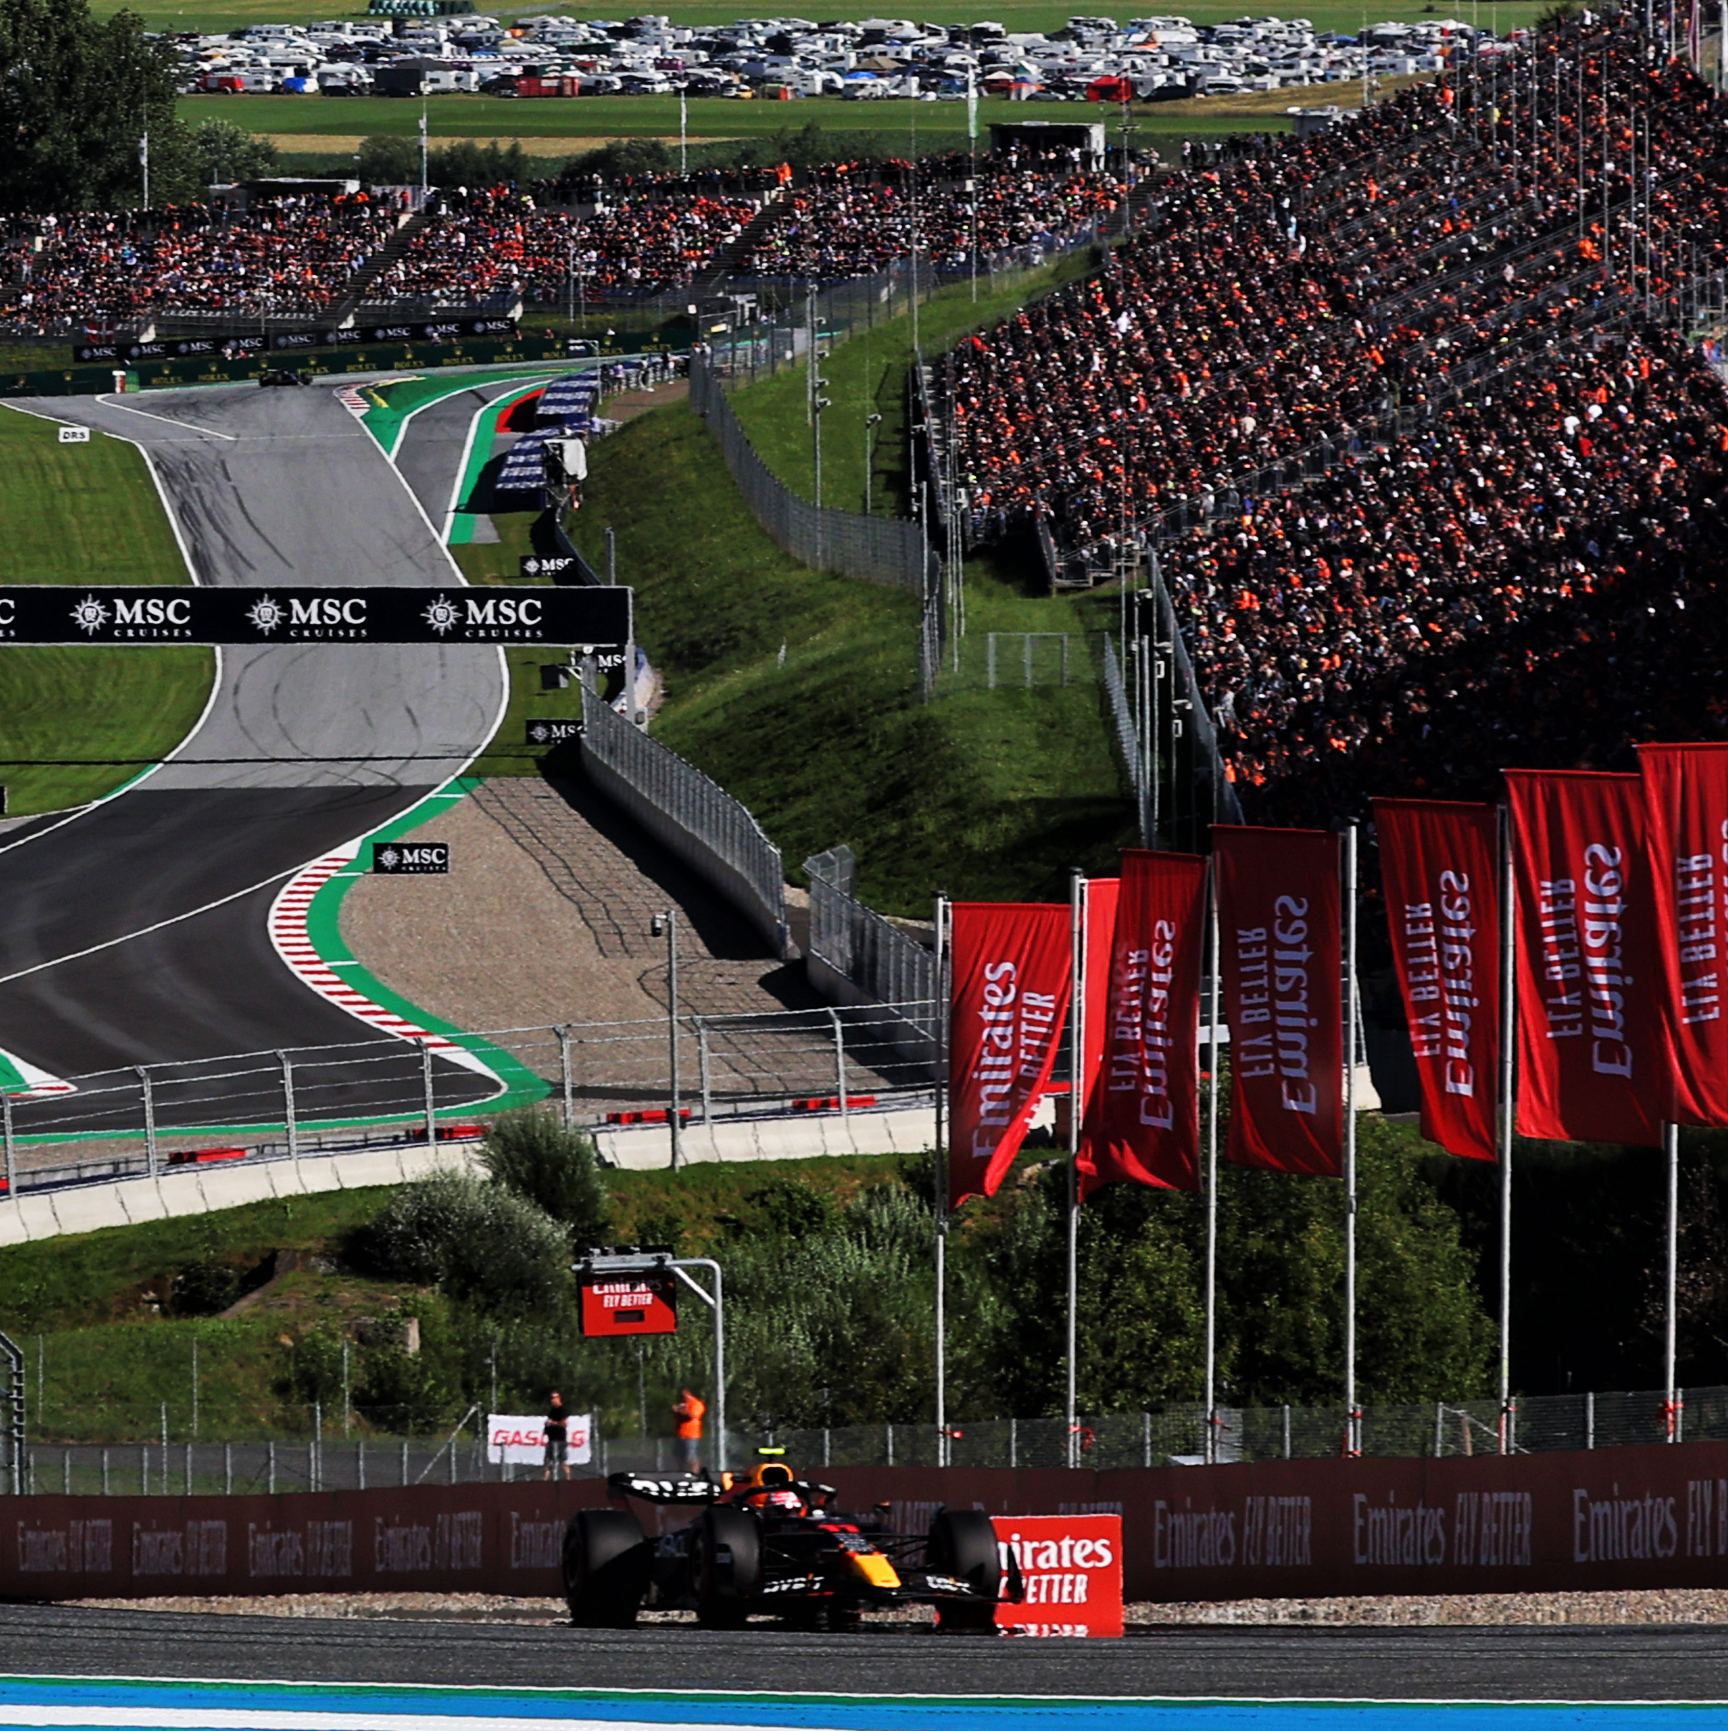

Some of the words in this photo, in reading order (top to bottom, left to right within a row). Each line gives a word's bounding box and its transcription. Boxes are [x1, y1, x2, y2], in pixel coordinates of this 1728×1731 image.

[63, 431, 86, 440] DRS
[113, 598, 191, 625] MSC
[289, 598, 367, 625] MSC
[465, 598, 542, 625] MSC
[113, 628, 192, 638] CRUISES
[289, 628, 368, 638] CRUISES
[465, 628, 543, 638] CRUISES
[402, 848, 446, 864] MSC
[1154, 1496, 1237, 1568] Emirates
[1353, 1490, 1445, 1565] Emirates
[1480, 1492, 1531, 1565] BETTER
[1573, 1482, 1678, 1562] Emirates
[997, 1533, 1113, 1570] irates
[1021, 1573, 1089, 1604] ETTER
